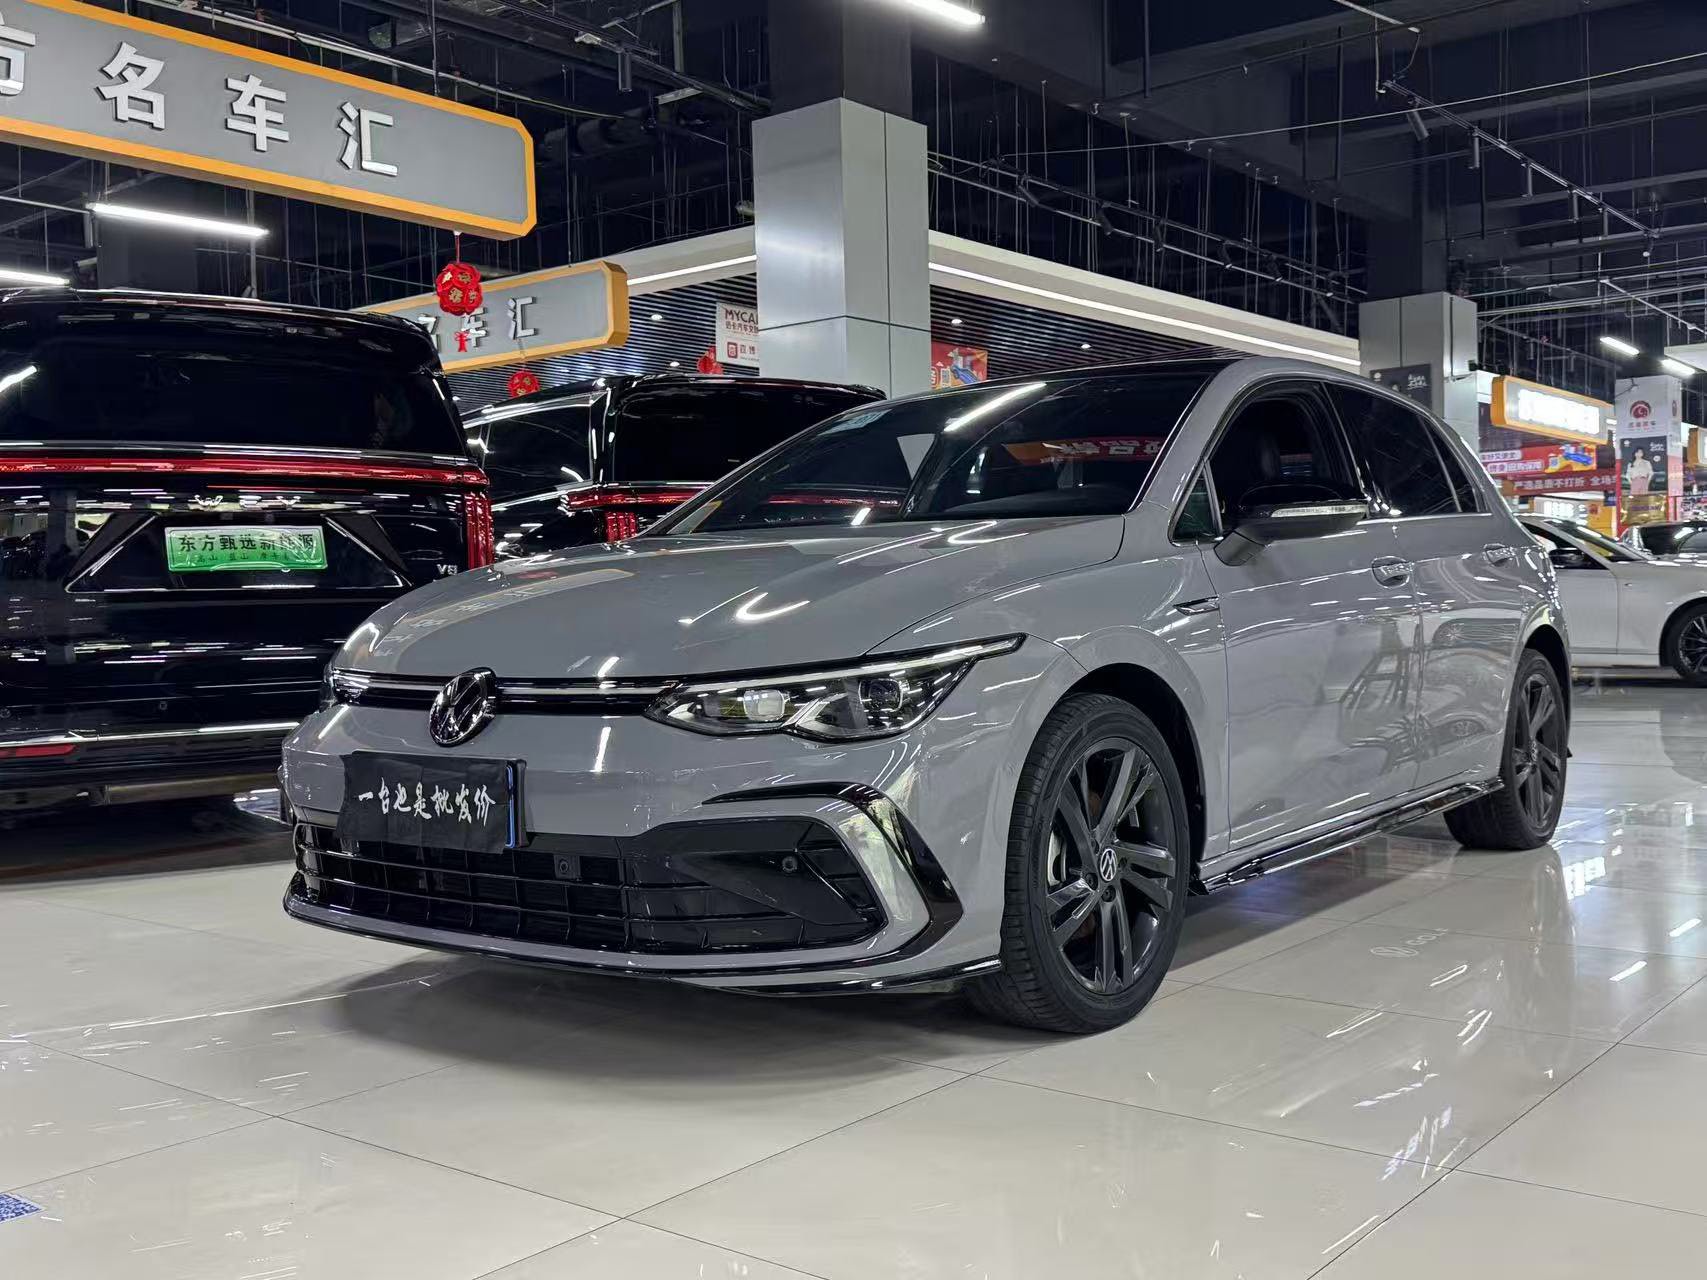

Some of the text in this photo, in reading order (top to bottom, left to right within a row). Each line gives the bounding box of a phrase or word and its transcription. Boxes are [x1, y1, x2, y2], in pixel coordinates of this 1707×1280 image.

[358, 777, 496, 826] 一台也是批发价
